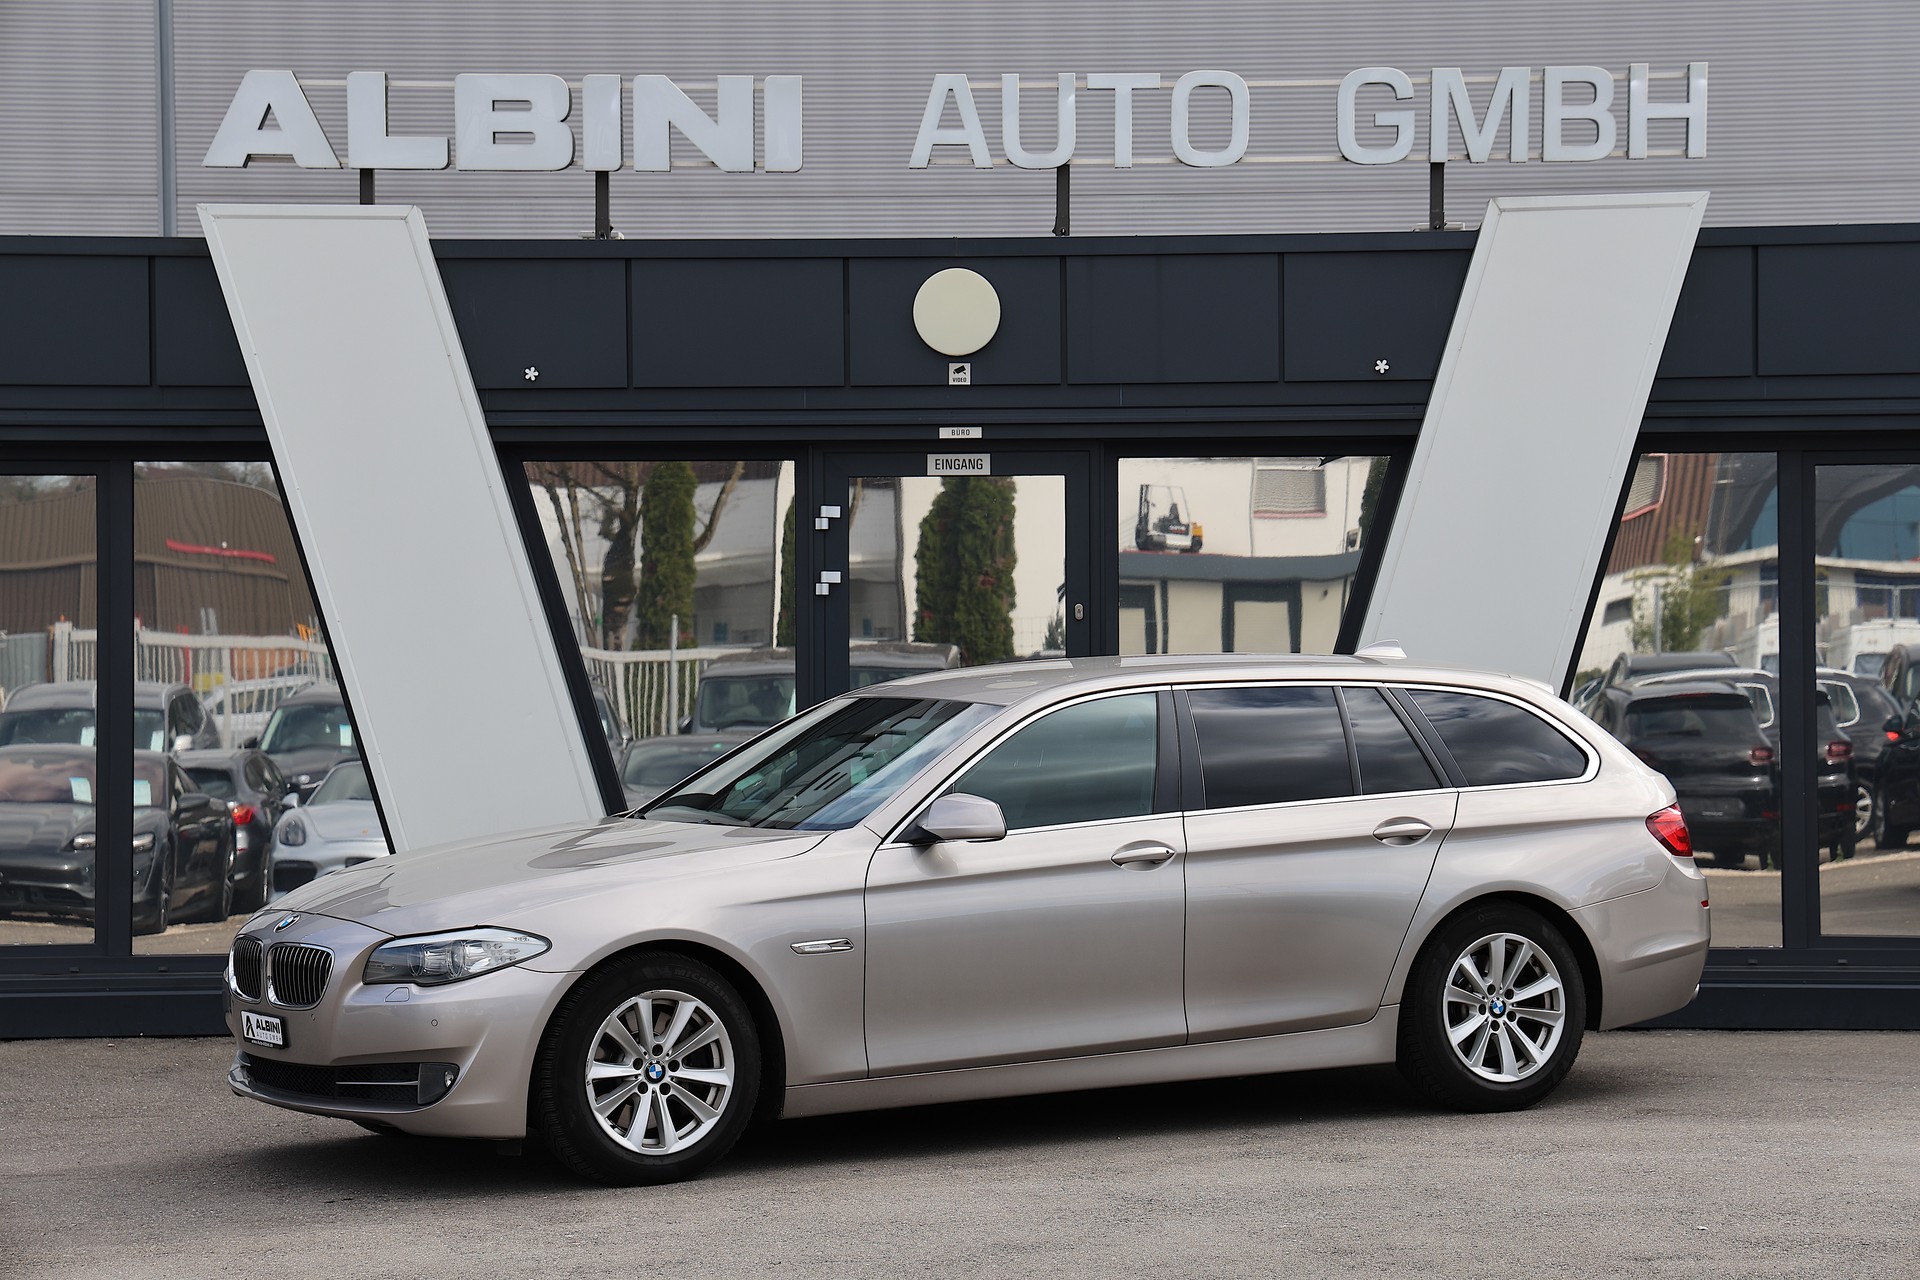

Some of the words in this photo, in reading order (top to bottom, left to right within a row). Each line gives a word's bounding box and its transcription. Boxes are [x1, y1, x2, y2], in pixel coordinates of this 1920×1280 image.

[202, 69, 804, 173] ALBINI
[908, 69, 1251, 171] AUTO
[1336, 61, 1710, 166] GMBH
[951, 427, 971, 436] BÜRO
[934, 458, 984, 471] EINGANG
[256, 1018, 281, 1034] ALBINI
